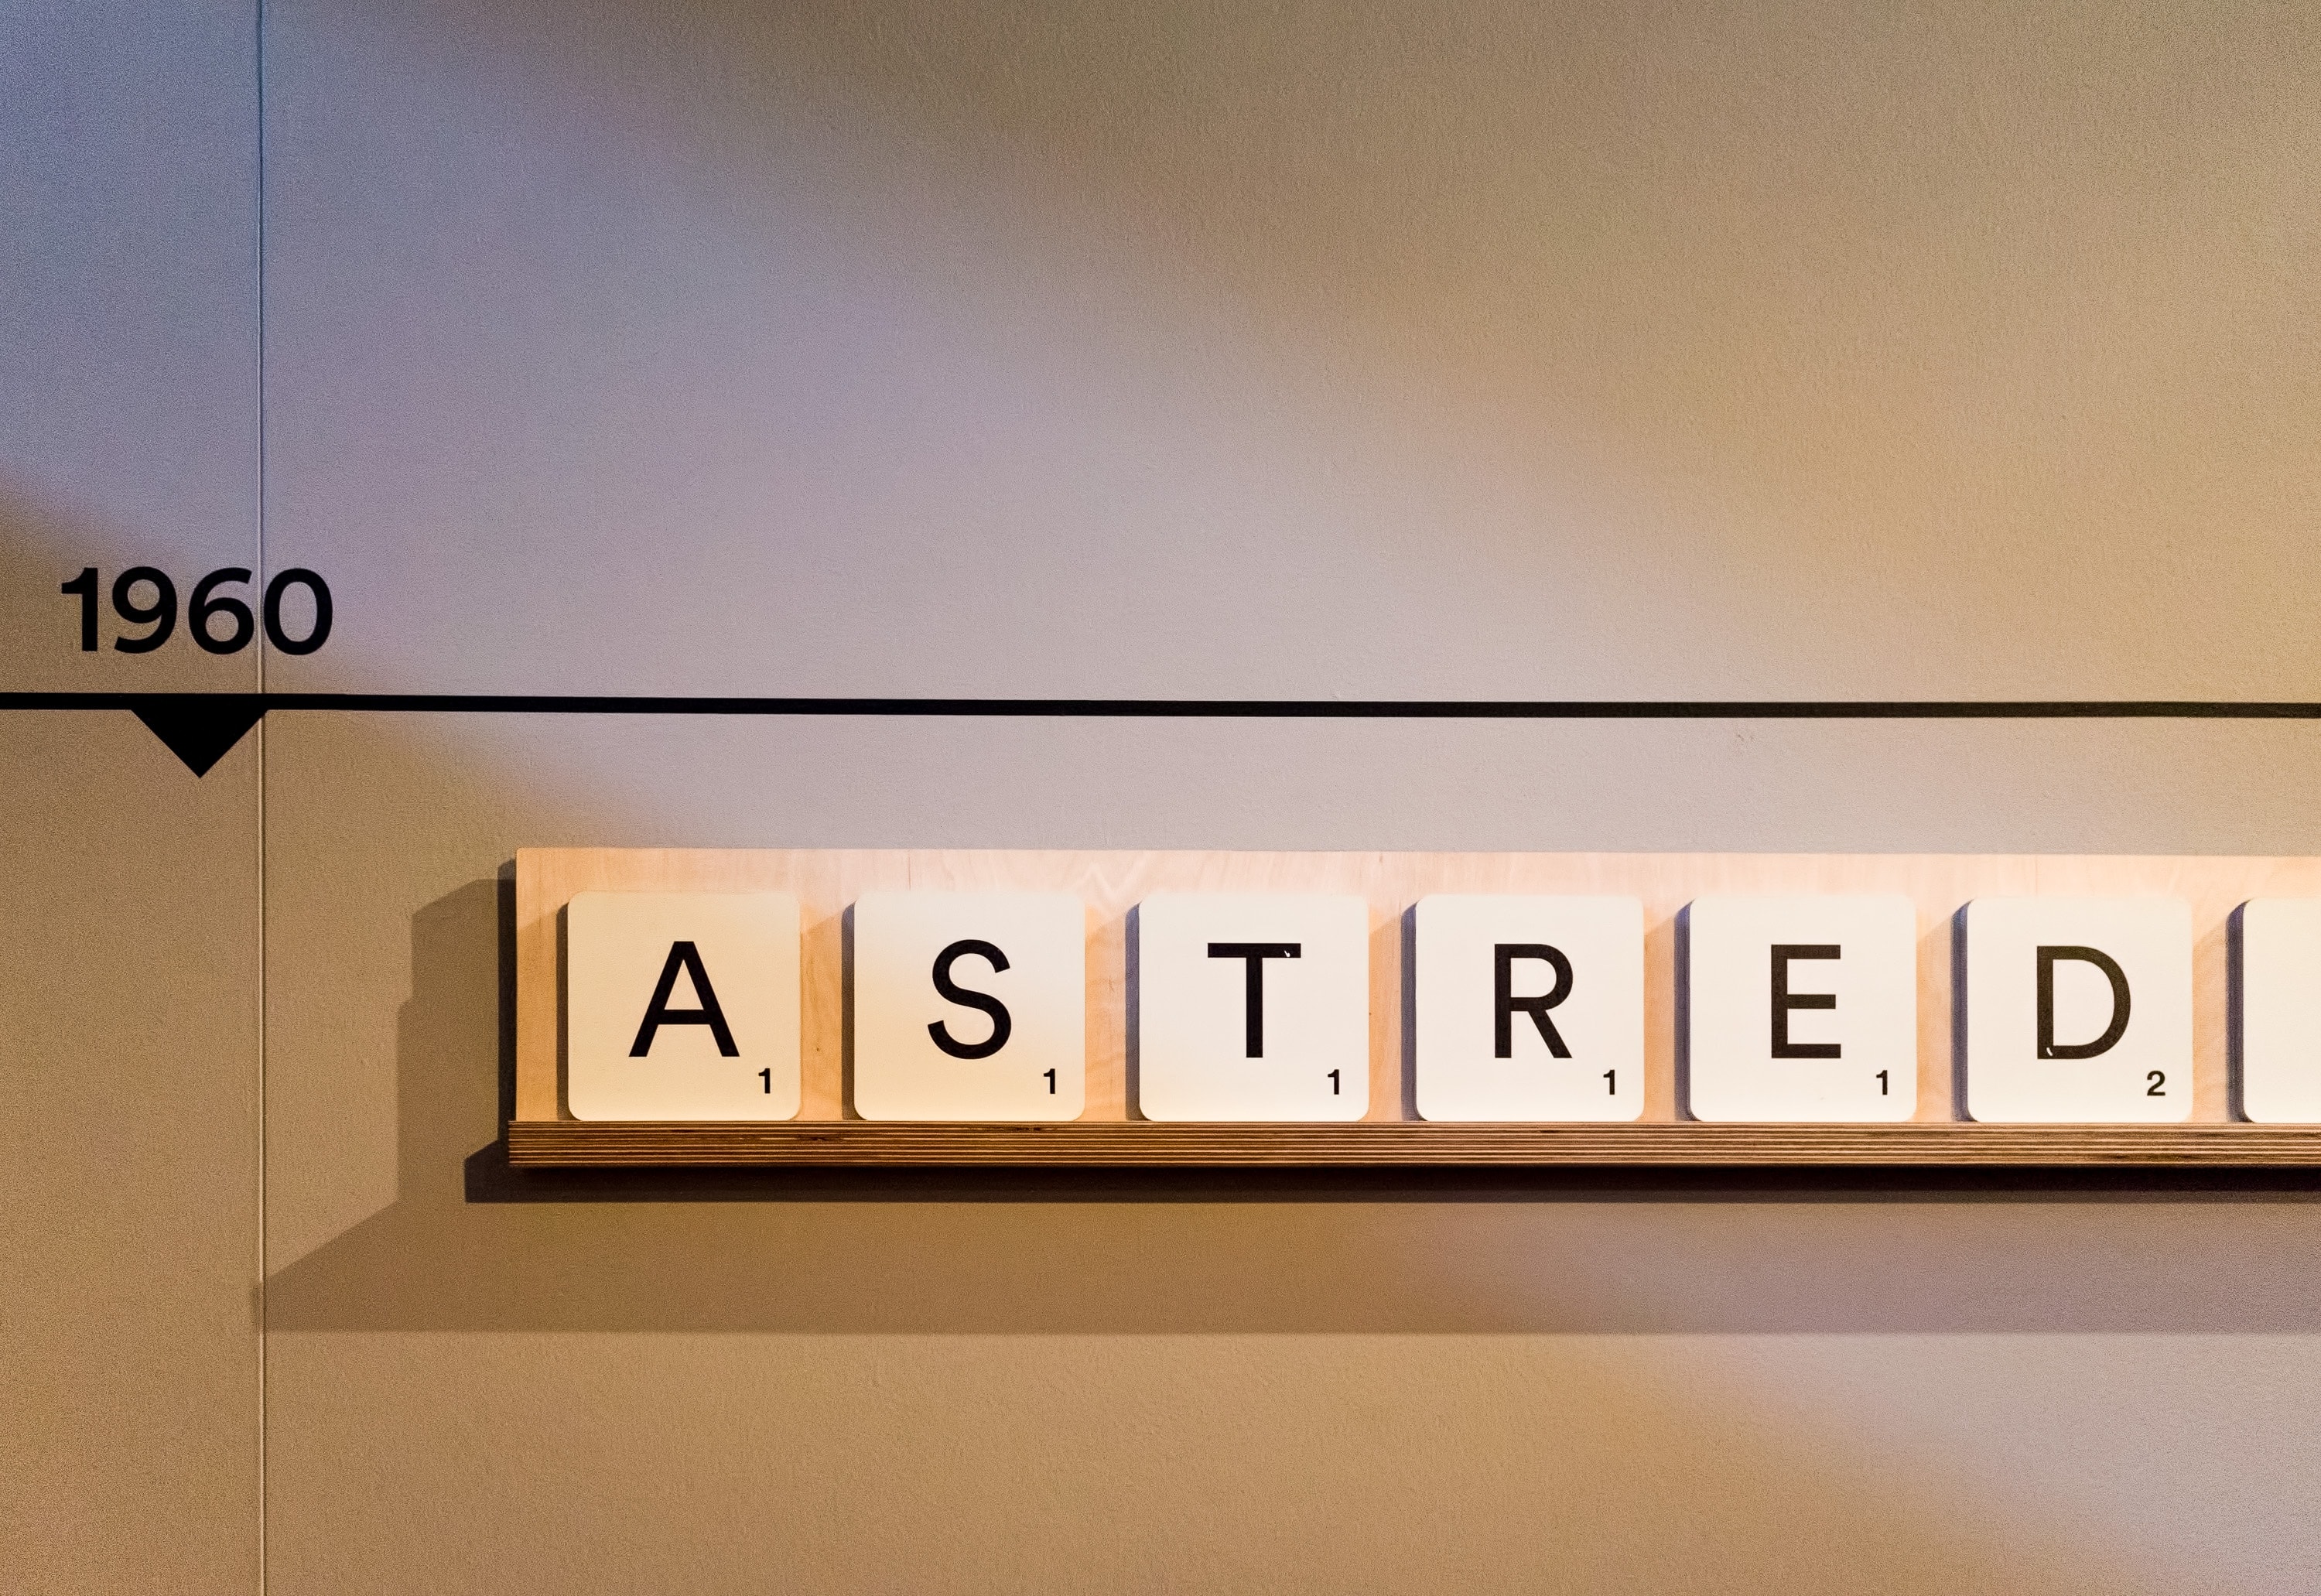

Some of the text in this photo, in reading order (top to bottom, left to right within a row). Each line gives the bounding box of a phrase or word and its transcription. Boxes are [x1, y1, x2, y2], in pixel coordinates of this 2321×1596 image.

[60, 566, 333, 656] 1960
[757, 1067, 771, 1095] 1
[1042, 1068, 1056, 1095] 1
[1327, 1068, 1340, 1095] 1
[1602, 1068, 1616, 1095] 1
[1875, 1069, 1889, 1095] 1
[2146, 1070, 2166, 1096] 2
